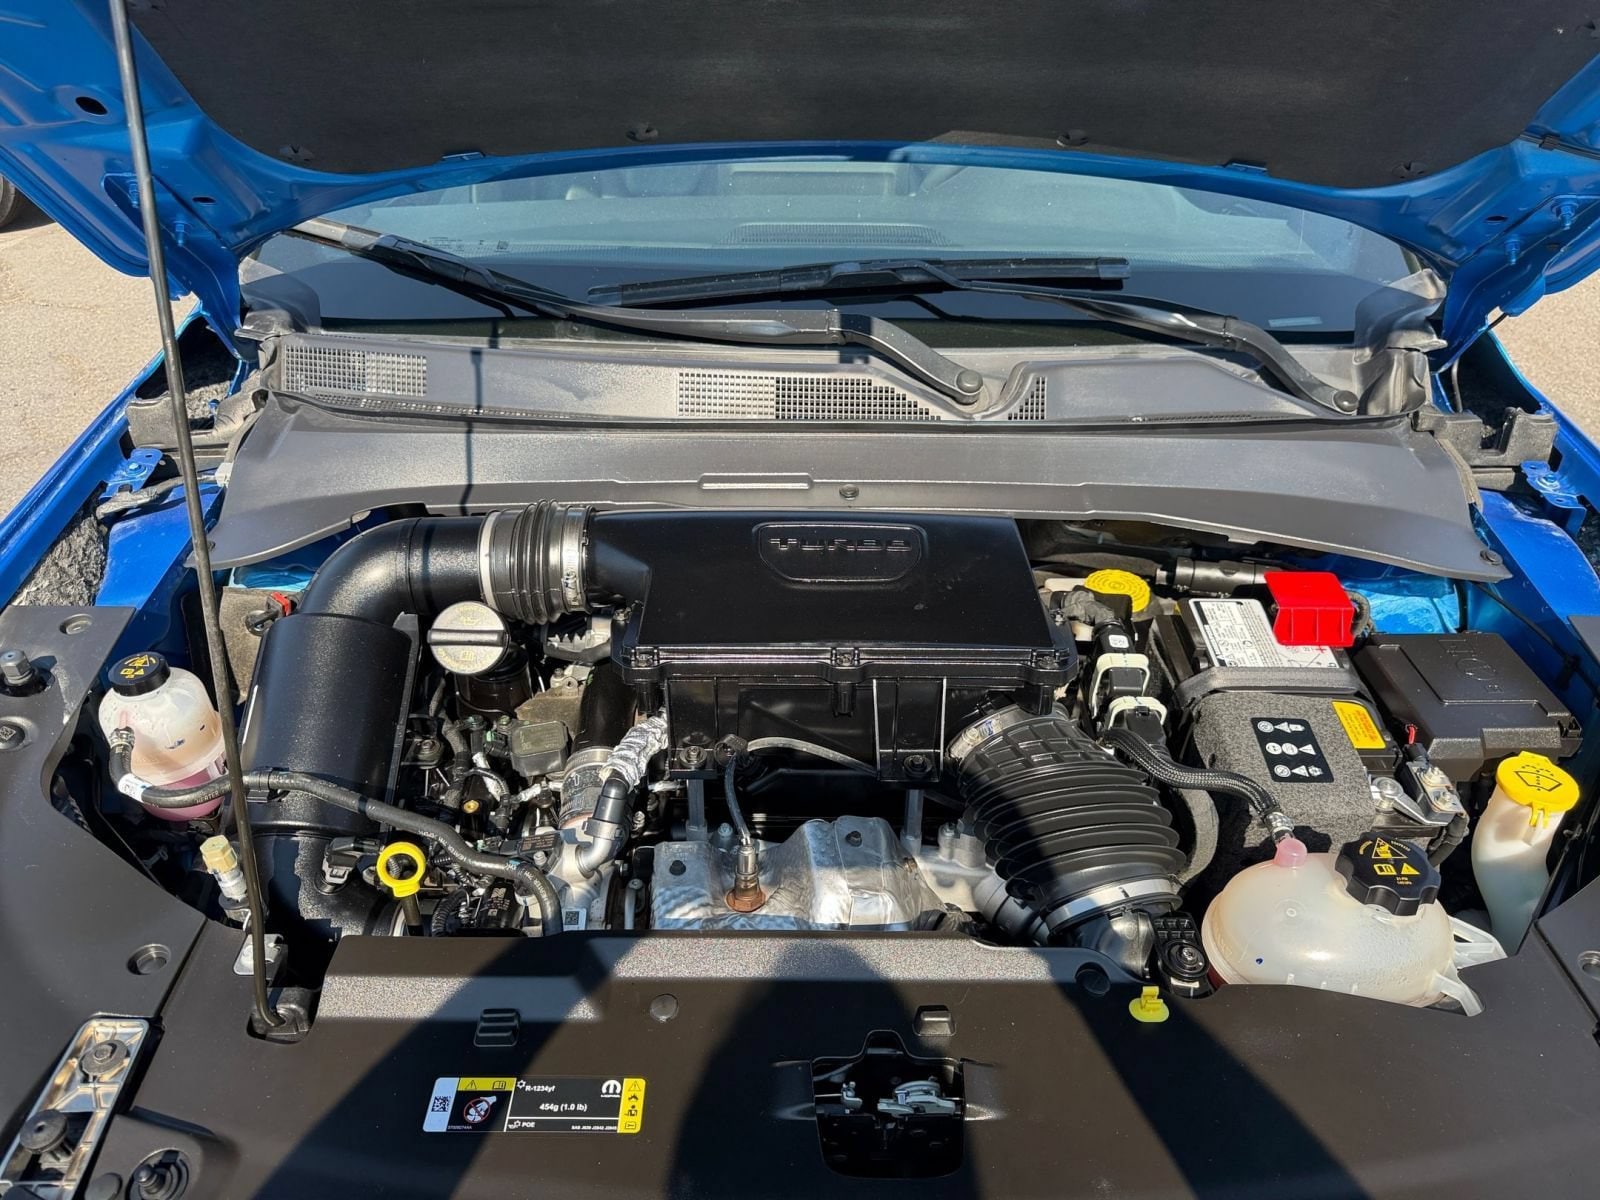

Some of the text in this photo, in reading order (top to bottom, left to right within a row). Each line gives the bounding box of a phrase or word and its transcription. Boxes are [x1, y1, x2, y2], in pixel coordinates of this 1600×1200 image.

[769, 538, 912, 552] TURBO
[525, 1085, 556, 1093] R-1234yf
[539, 1103, 588, 1112] 454g (1.0 lb)
